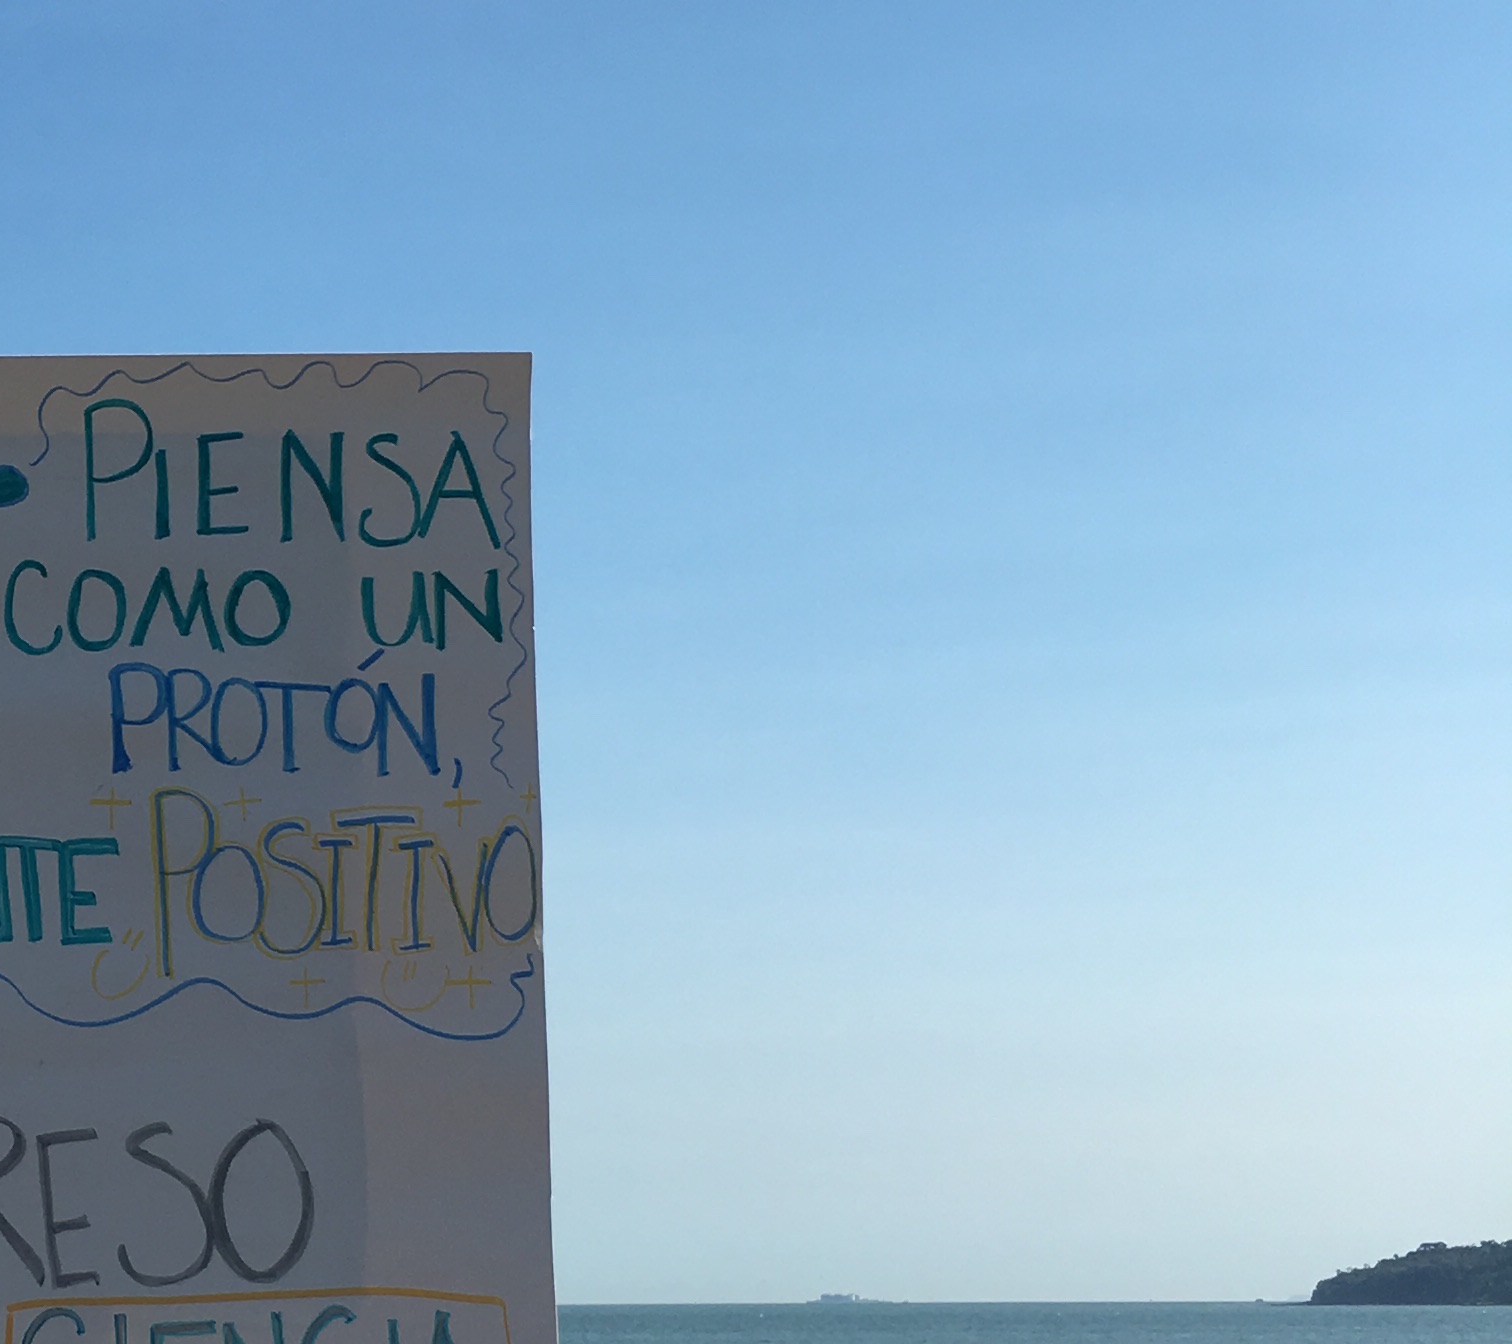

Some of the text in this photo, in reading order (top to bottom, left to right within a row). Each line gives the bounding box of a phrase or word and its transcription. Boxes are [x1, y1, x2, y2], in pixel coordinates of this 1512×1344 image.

[85, 399, 501, 549] PIENSA
[4, 560, 503, 654] COMO UN
[108, 648, 463, 788] PROTÓN,
[152, 787, 537, 977] POSITIVO
